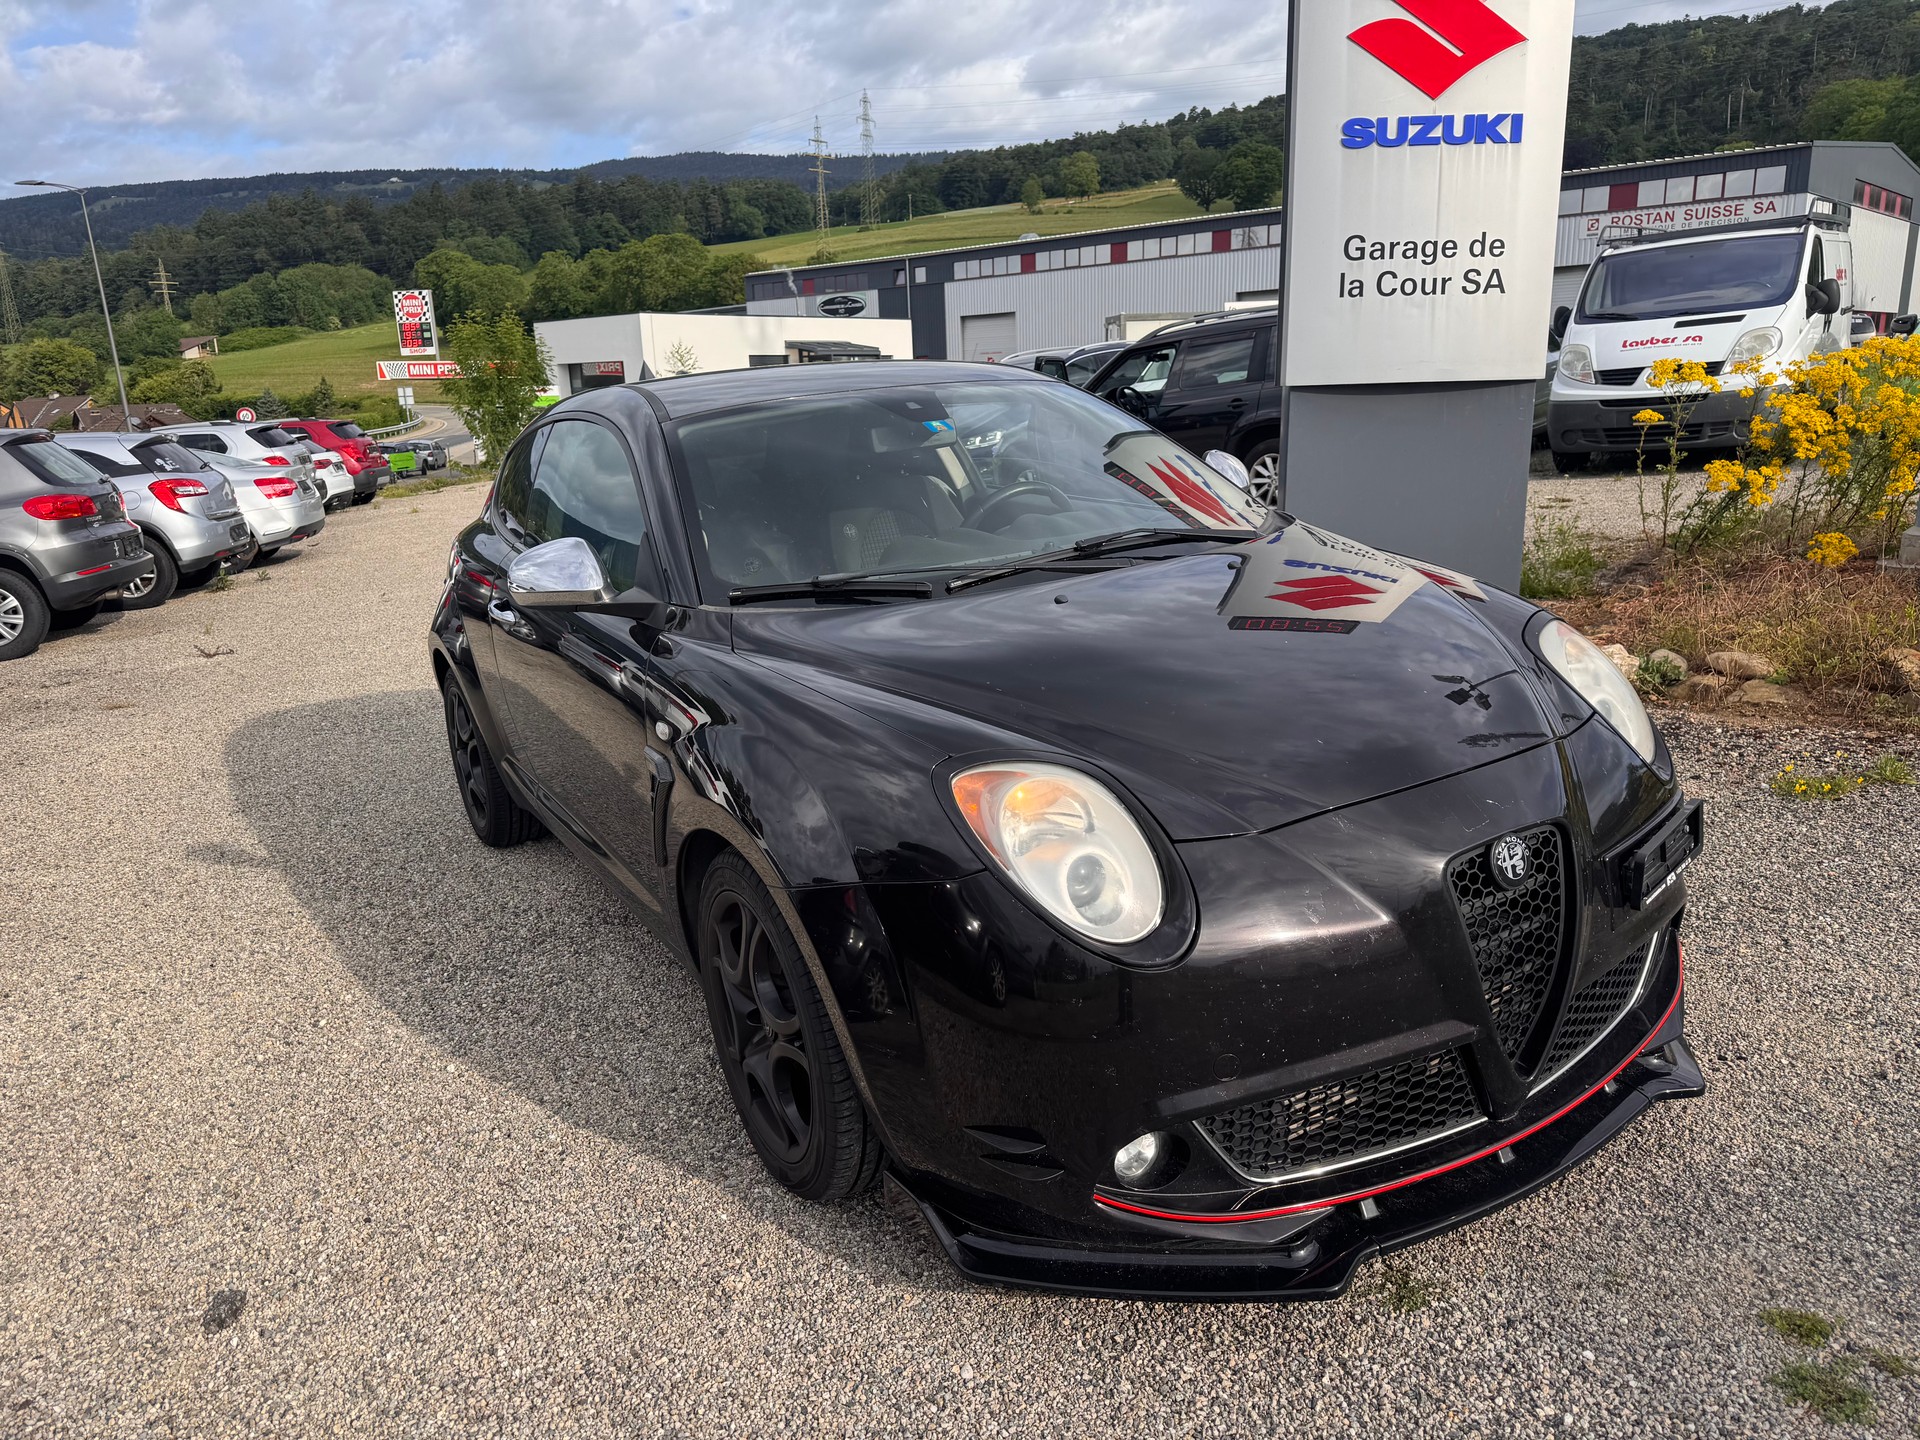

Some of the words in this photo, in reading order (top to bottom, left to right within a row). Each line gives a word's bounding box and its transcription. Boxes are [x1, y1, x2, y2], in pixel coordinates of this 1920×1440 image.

[1341, 113, 1524, 149] SUZUKI
[1611, 211, 1676, 226] ROSTAN
[1683, 204, 1745, 221] SUISSE
[1753, 201, 1777, 214] SA
[1343, 235, 1458, 265] Garage
[1469, 232, 1506, 257] de
[1339, 273, 1364, 298] la
[1376, 270, 1452, 296] Cour
[1462, 269, 1506, 295] SA
[402, 299, 422, 307] MINI
[404, 306, 422, 314] PRIX
[409, 364, 435, 375] MINI
